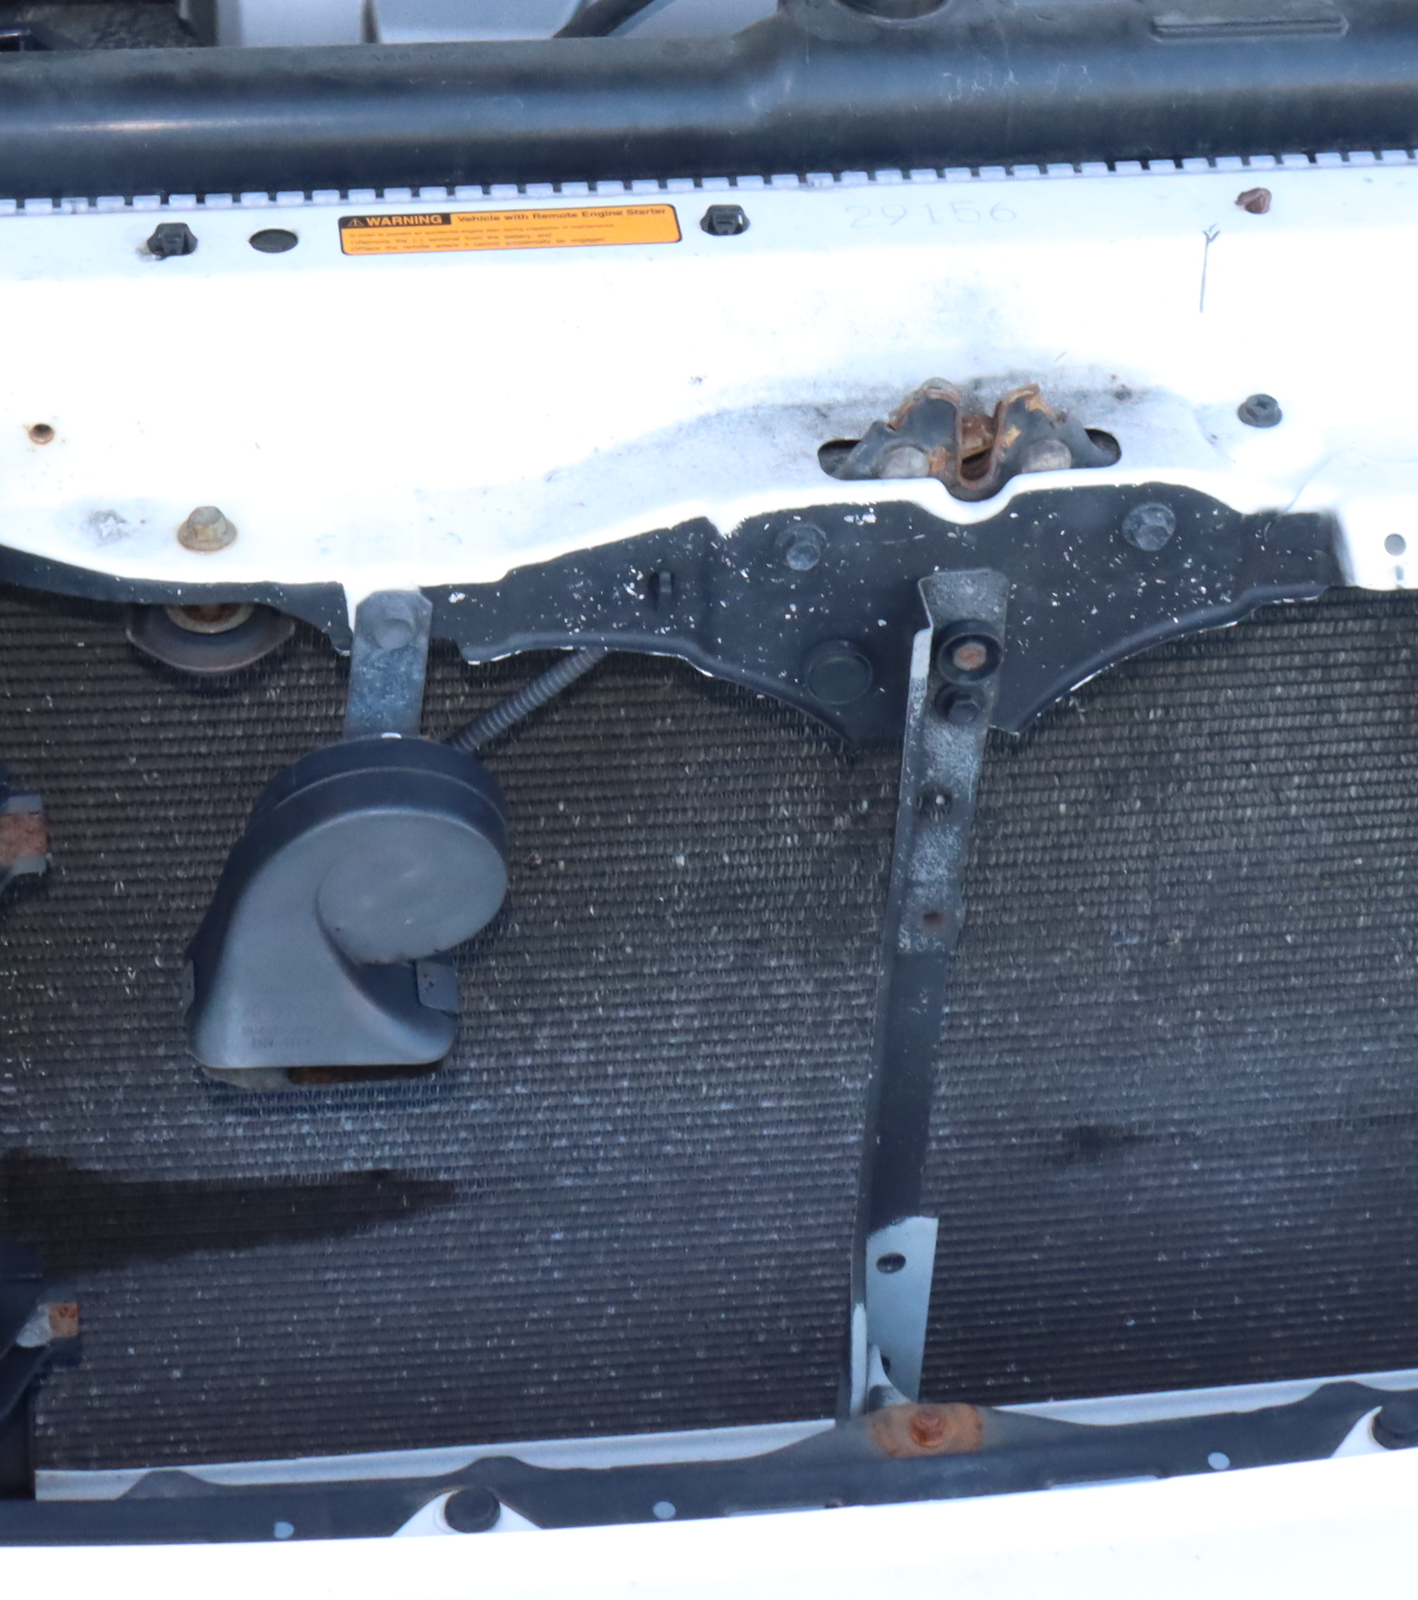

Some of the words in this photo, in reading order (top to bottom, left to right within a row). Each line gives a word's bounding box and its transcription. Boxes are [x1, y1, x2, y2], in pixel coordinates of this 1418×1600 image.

[366, 214, 443, 227] WARNING
[458, 214, 500, 223] Vehicle
[504, 213, 529, 221] with
[532, 211, 578, 220] Remote
[581, 210, 623, 219] Engine
[626, 208, 666, 216] Starter
